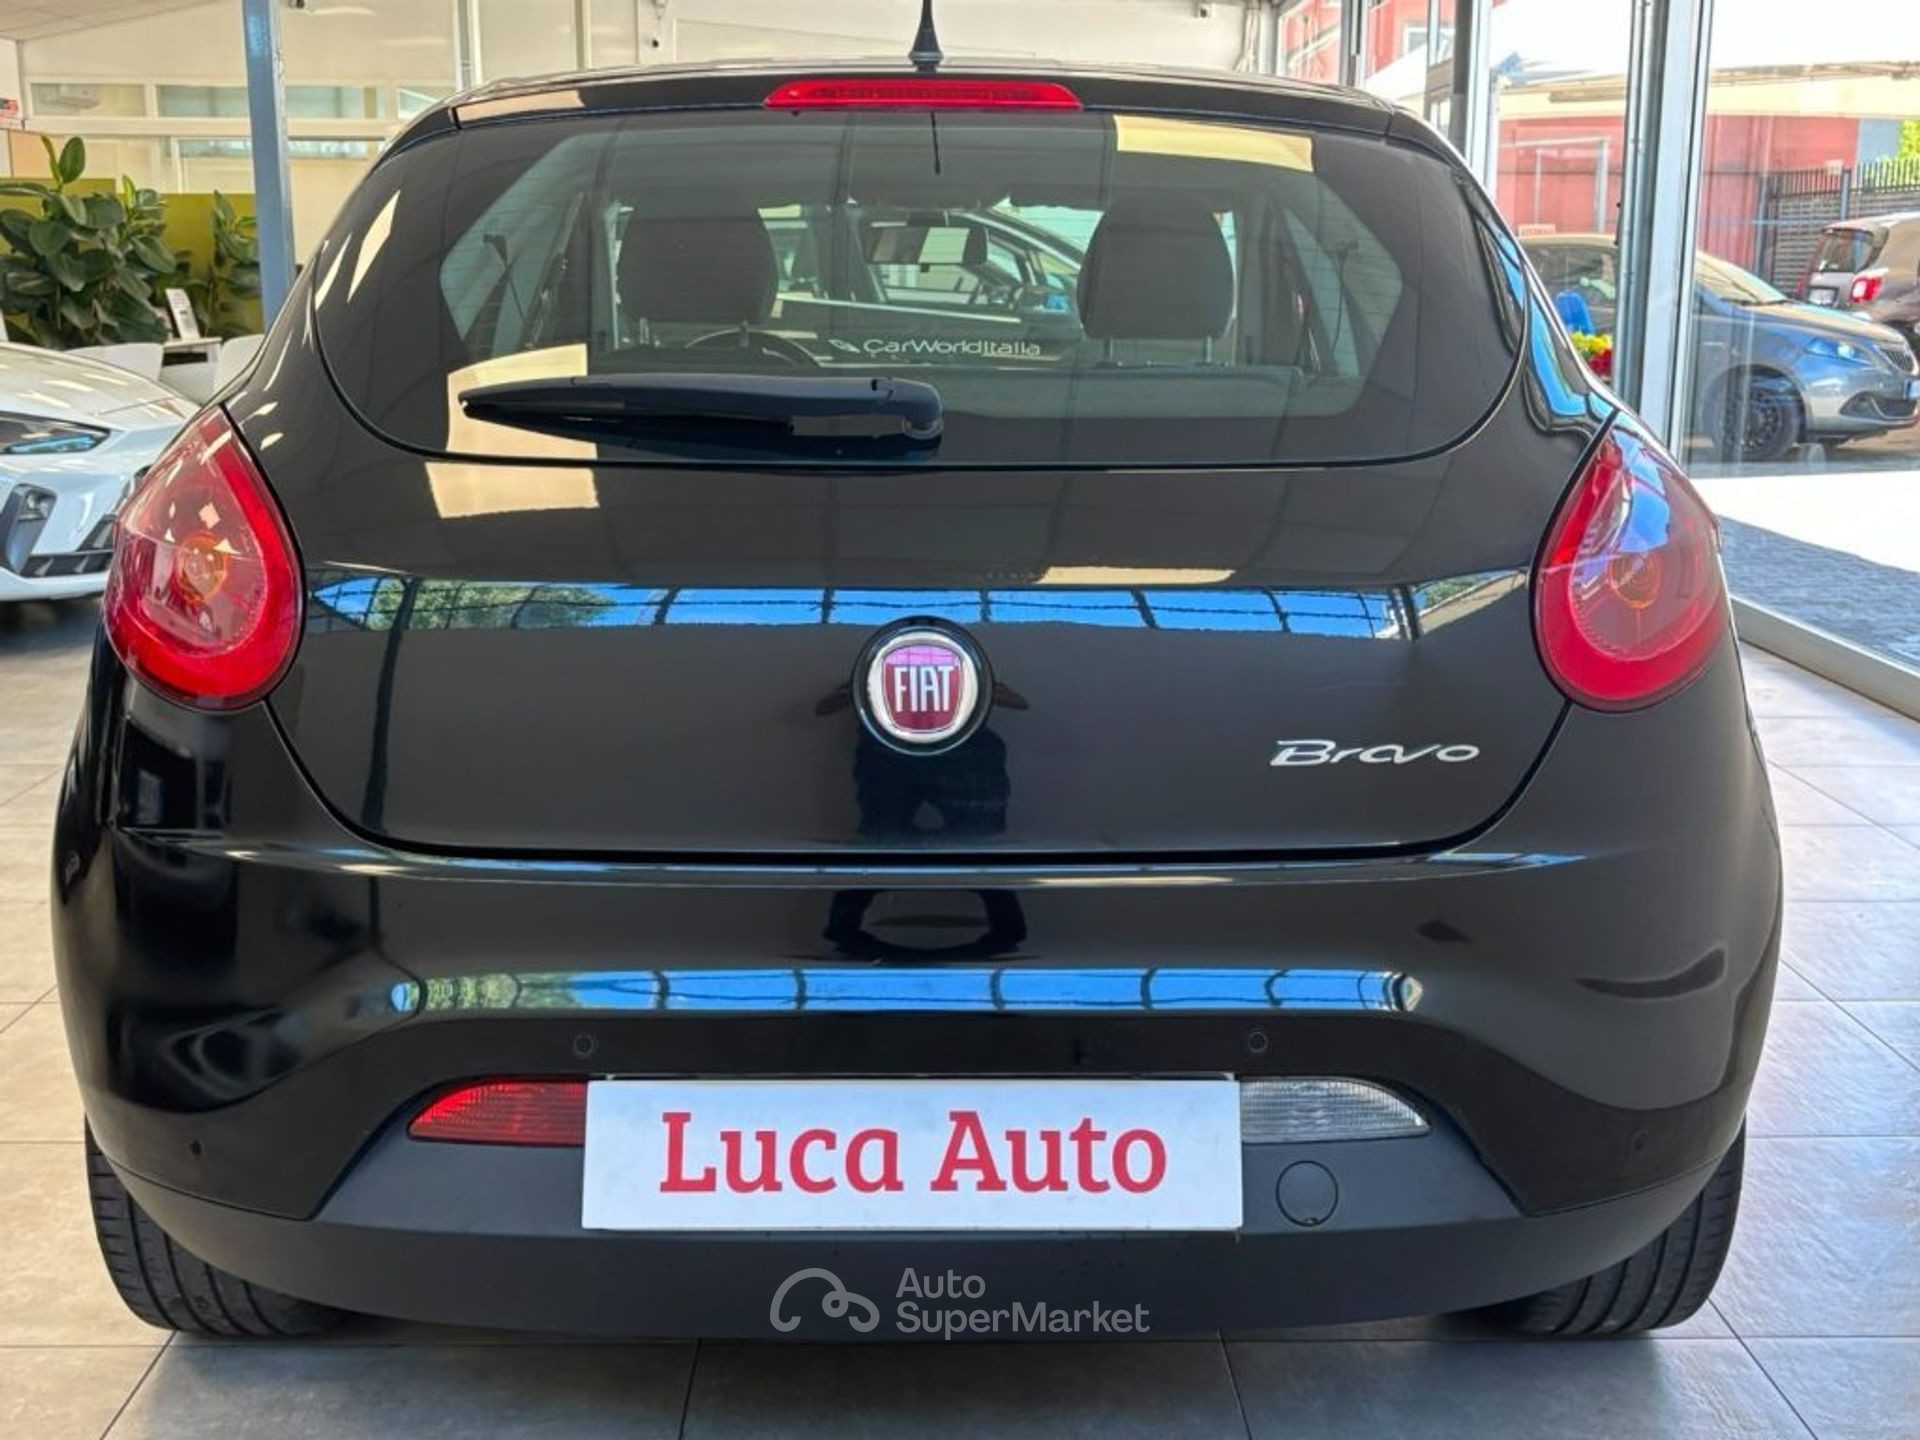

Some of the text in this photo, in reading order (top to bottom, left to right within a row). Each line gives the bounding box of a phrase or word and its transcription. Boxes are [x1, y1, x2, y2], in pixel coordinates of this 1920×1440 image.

[893, 664, 954, 713] FIAT
[1269, 739, 1480, 767] Bravo
[660, 1111, 1166, 1193] Luca Auto
